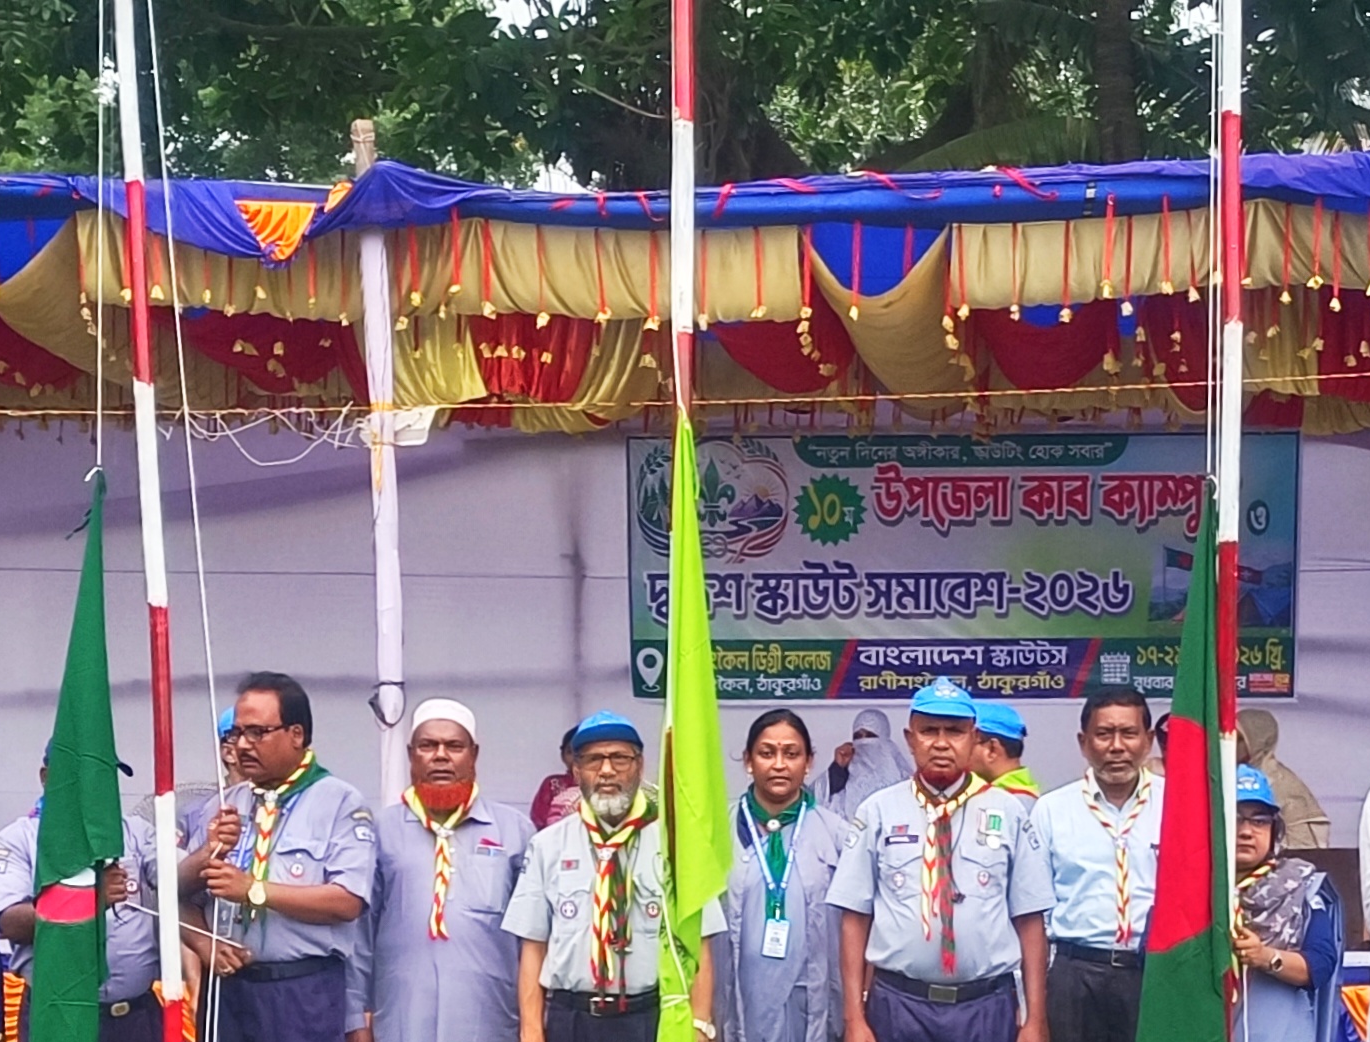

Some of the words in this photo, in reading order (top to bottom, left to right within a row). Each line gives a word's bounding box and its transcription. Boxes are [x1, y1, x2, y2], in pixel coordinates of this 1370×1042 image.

[855, 442, 897, 461] দিনের
[1028, 444, 1064, 461] হোক
[873, 464, 1009, 537] উপজেলা
[1020, 473, 1090, 521] কাব
[1099, 472, 1204, 537] ক্যাম্পু
[1250, 506, 1267, 531] ও
[750, 560, 857, 619] স্কাউট
[865, 569, 1132, 619] সমাবেশ-২০২৬
[752, 643, 782, 674] ডিগ্রী
[784, 650, 832, 671] কলেজ
[857, 645, 985, 667] বাংলাদেশ
[990, 640, 1068, 668] স্কাউটস
[756, 673, 822, 696] ঠাকুরগাঁও
[977, 670, 1065, 695] ঠাকুরগাঁও
